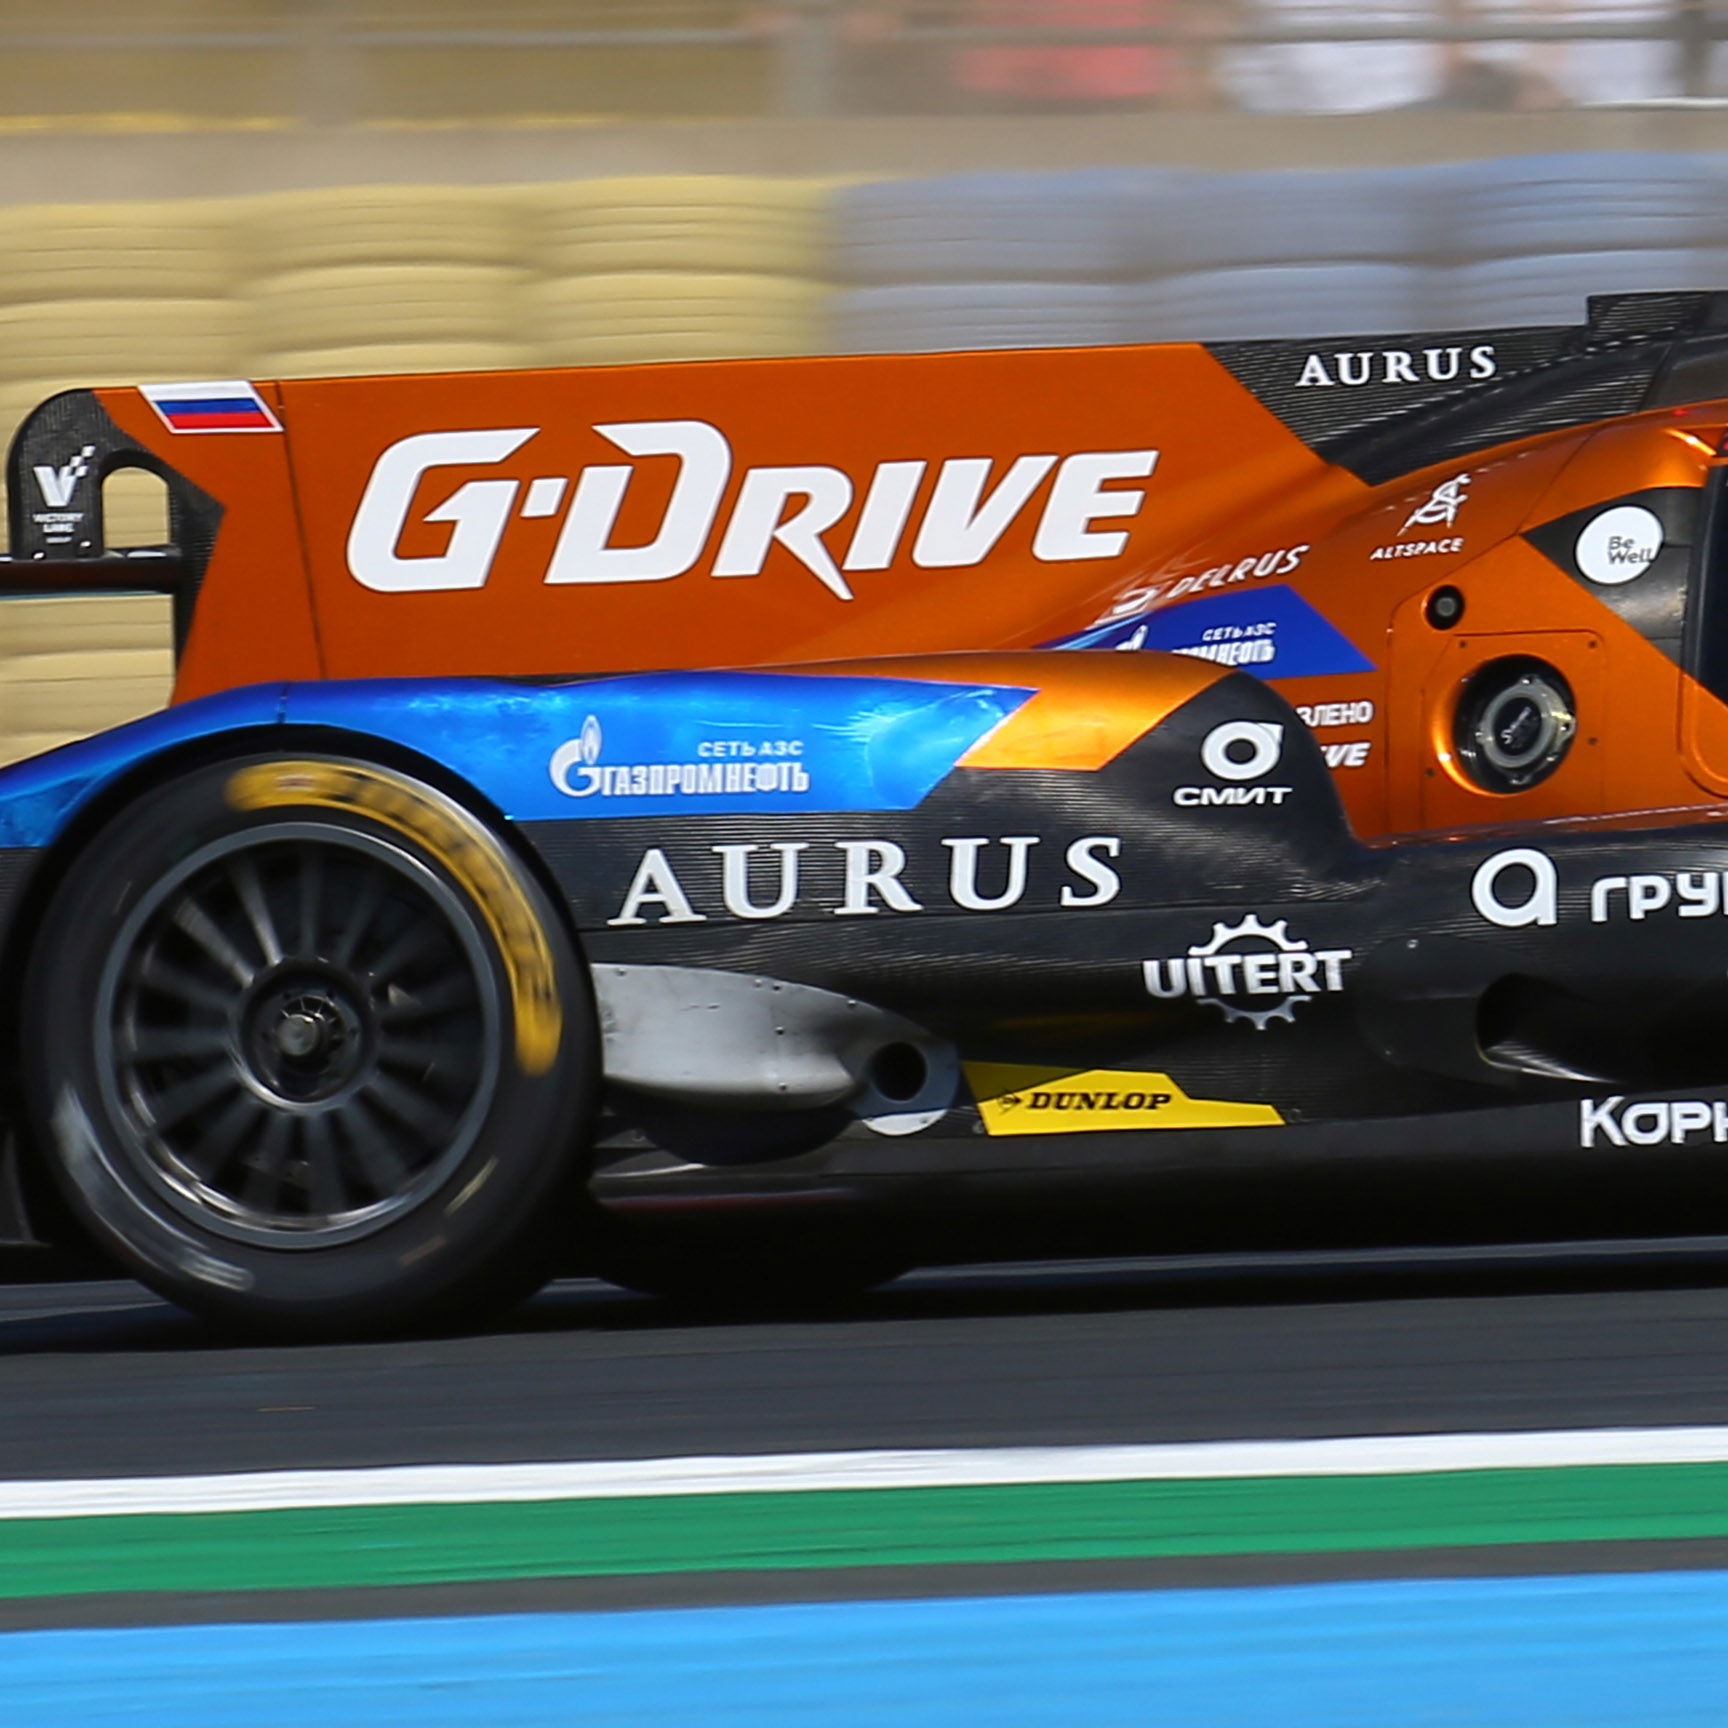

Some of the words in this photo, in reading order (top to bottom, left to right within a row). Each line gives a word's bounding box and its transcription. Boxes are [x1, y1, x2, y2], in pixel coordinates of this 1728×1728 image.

[1295, 346, 1495, 387] AURUS
[1369, 537, 1465, 561] ALTSPACE
[1608, 536, 1635, 550] Be
[1607, 548, 1653, 565] Well
[1167, 545, 1310, 599] DELRUS
[697, 742, 755, 757] СЕТЬ
[758, 740, 804, 755] АЗС
[601, 762, 810, 796] ГАЗПРОМНЕФТЬ
[1173, 786, 1292, 806] СМИТ
[606, 836, 1123, 926] AURUS
[1143, 950, 1353, 998] UITERT
[1026, 1092, 1171, 1110] DUNLOP
